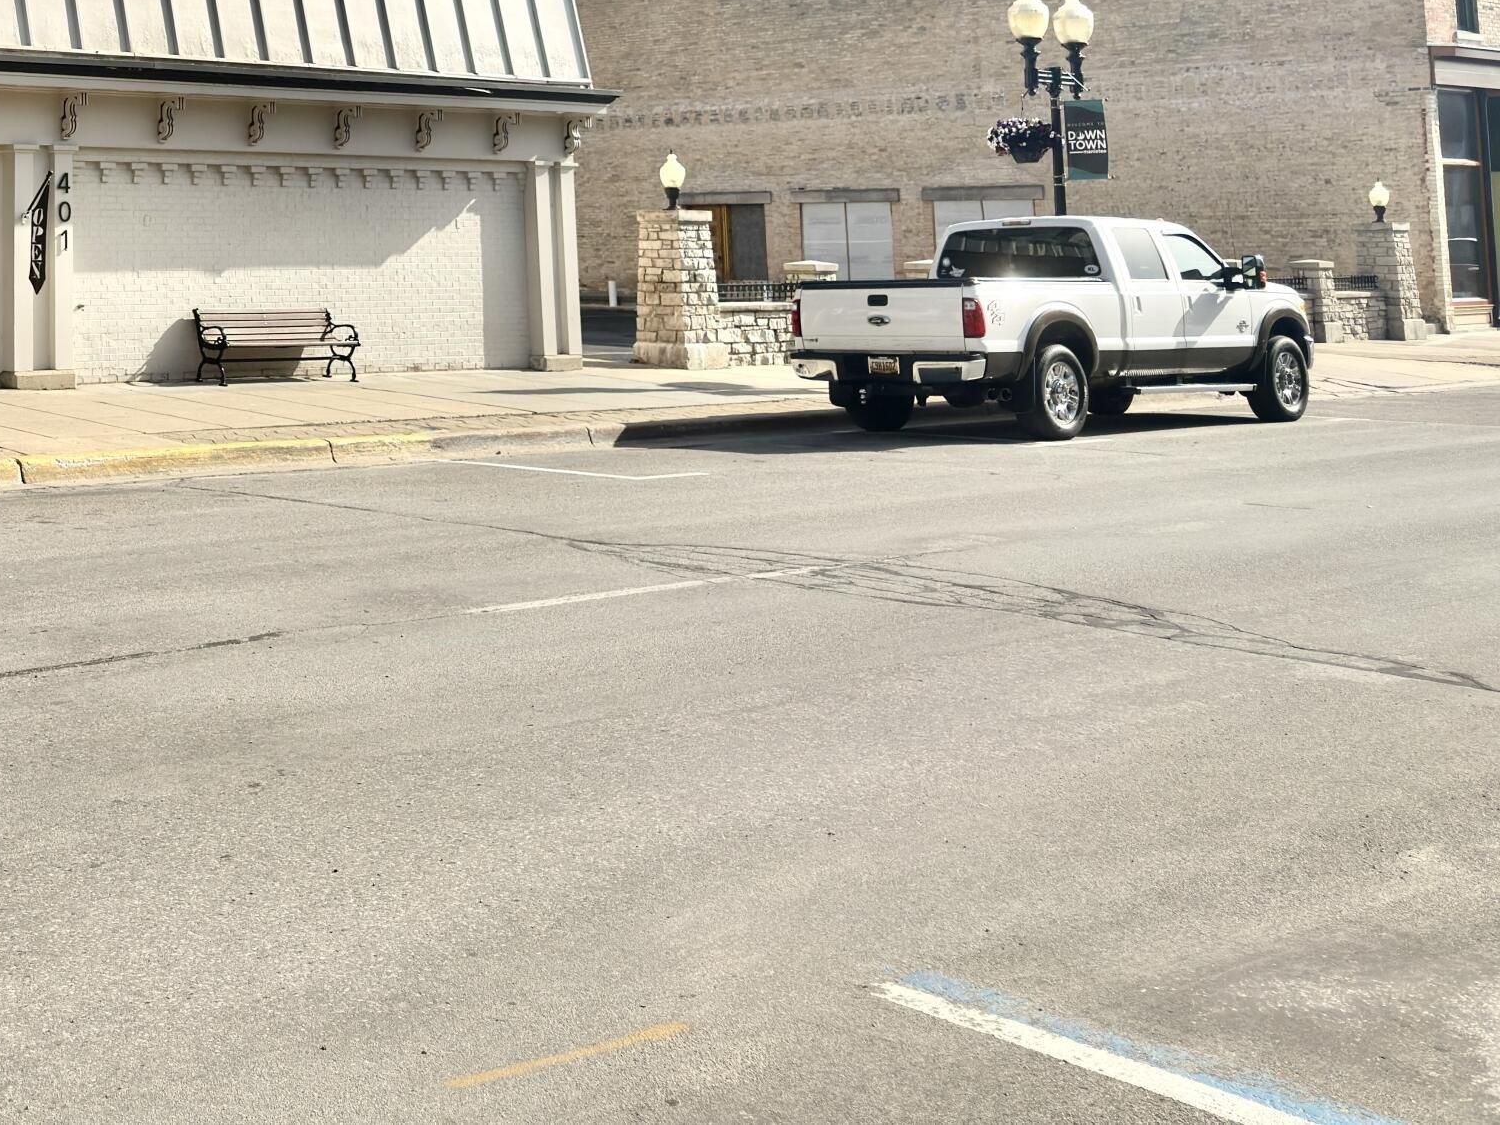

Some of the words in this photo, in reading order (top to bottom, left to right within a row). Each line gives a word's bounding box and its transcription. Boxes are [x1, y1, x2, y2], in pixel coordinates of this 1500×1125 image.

[1068, 139, 1107, 151] TOWN
[31, 207, 44, 280] OPEN
[57, 172, 72, 251] 401
